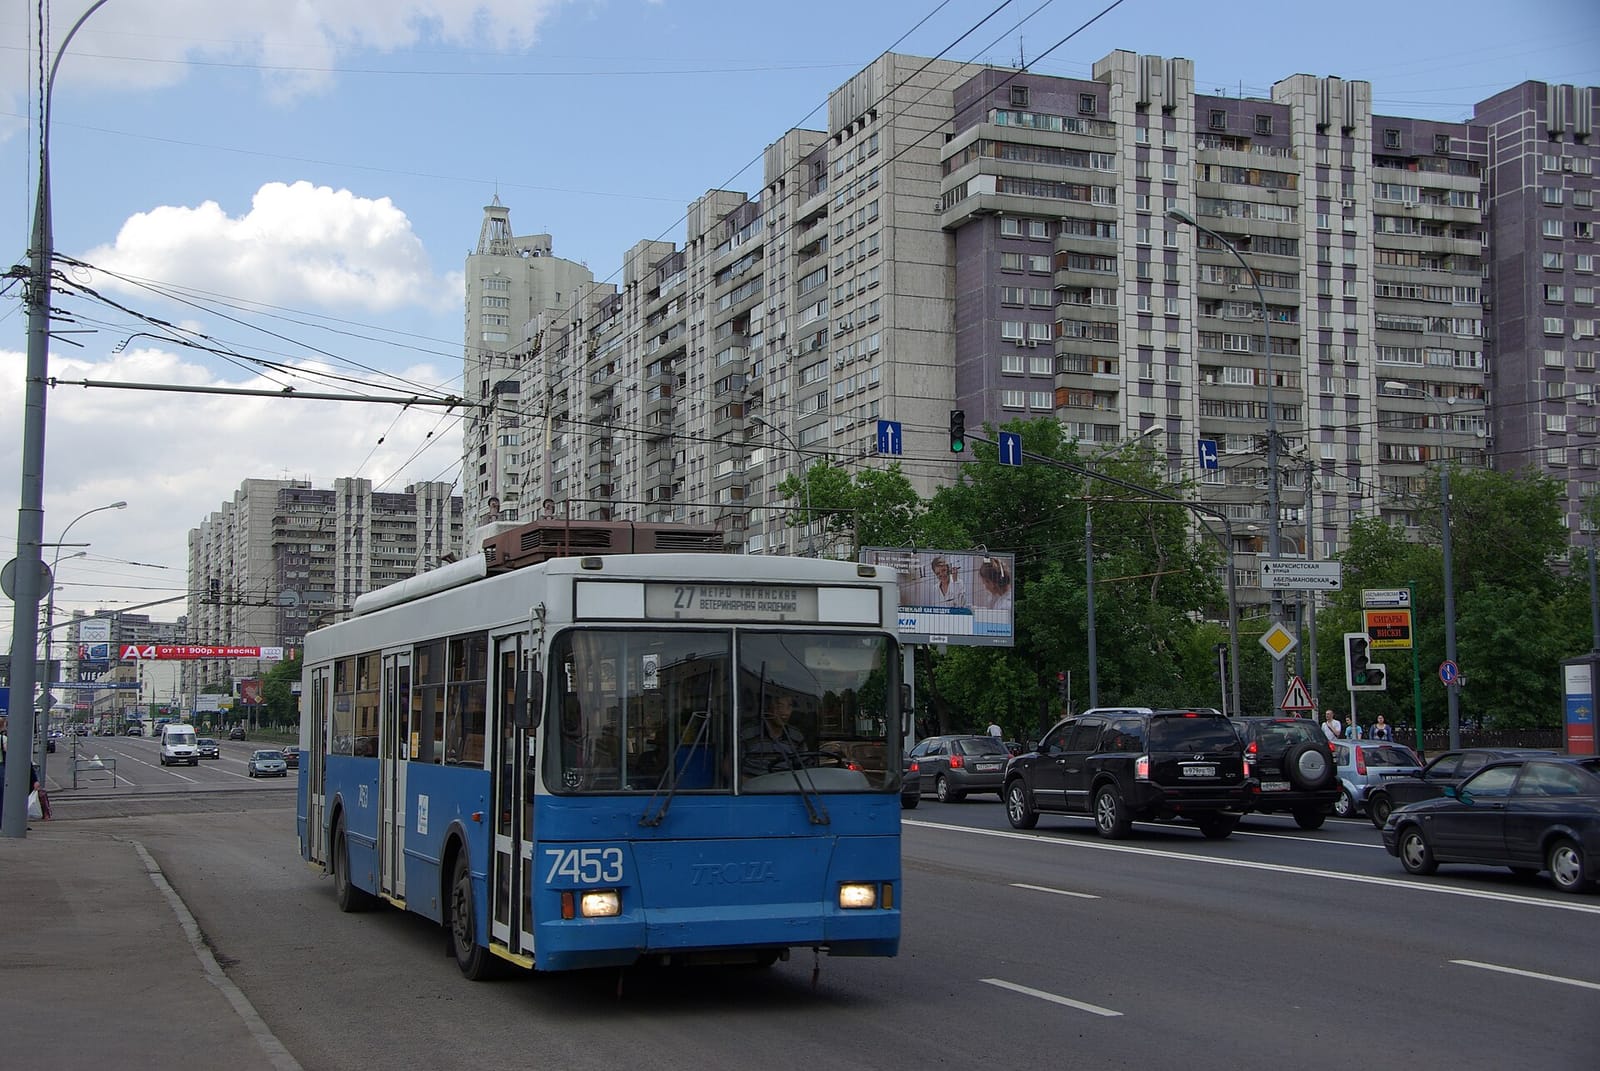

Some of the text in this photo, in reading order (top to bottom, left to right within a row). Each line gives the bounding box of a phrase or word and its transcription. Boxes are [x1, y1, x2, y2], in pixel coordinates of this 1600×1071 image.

[673, 586, 797, 609] 27 МЕТРО ТАГАНСКАЯ
[700, 600, 797, 612] ВЕТЕРИНАРНАЯ АКАДЕМИЯ
[898, 618, 917, 626] KIN
[1373, 615, 1403, 624] СИГАРЫ
[1376, 629, 1402, 637] ВИСКИ
[121, 645, 158, 660] A4
[227, 648, 256, 656] месяц
[545, 848, 624, 884] 7453
[691, 860, 781, 886] TROLZA
